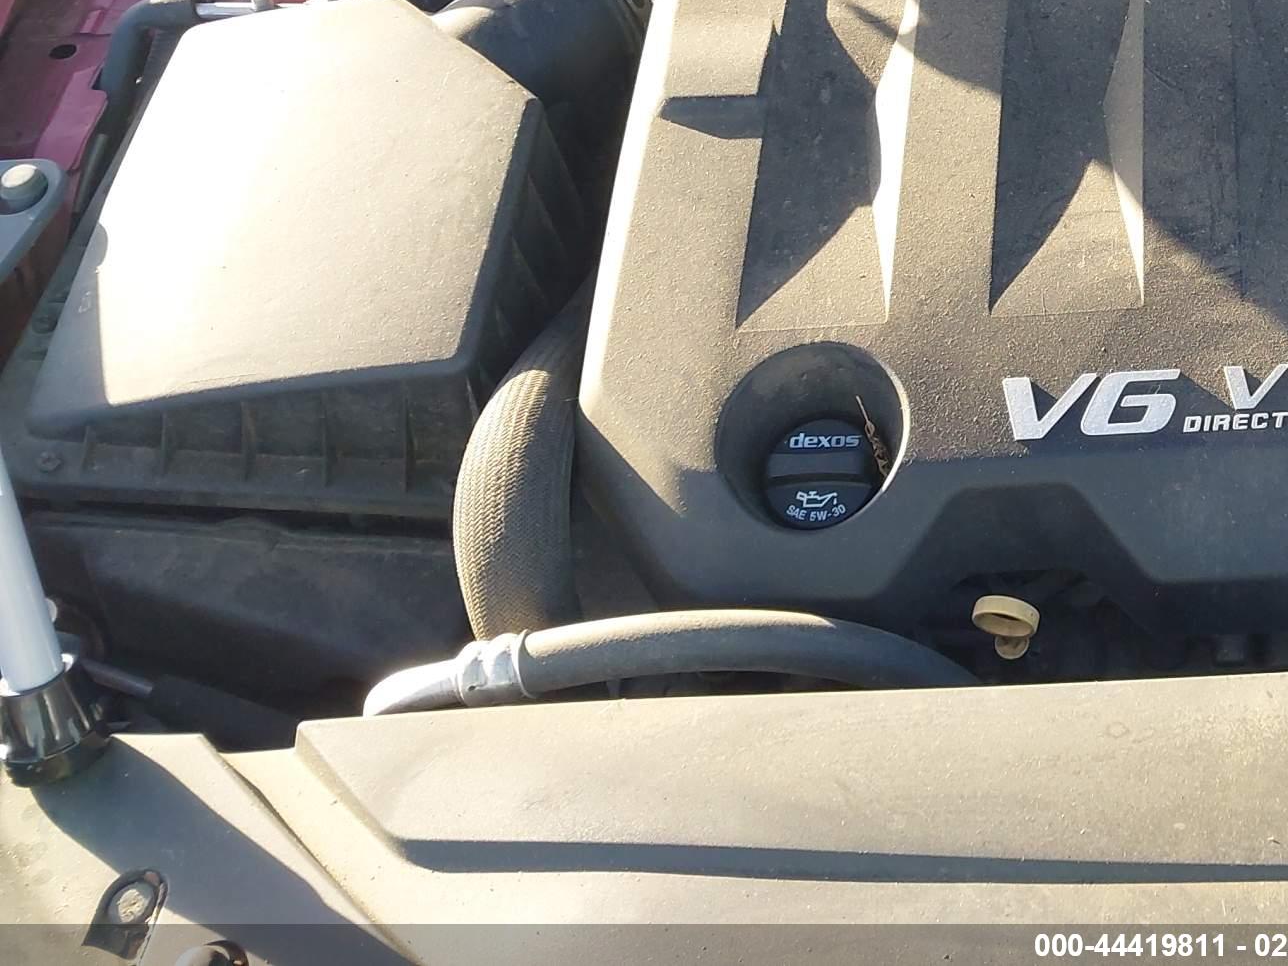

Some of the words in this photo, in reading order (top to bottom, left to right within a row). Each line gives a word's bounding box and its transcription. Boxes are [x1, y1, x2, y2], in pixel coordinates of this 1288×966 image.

[1002, 369, 1182, 442] V6
[789, 432, 862, 449] dexos
[786, 504, 807, 521] SAE
[809, 504, 847, 522] 5W-30
